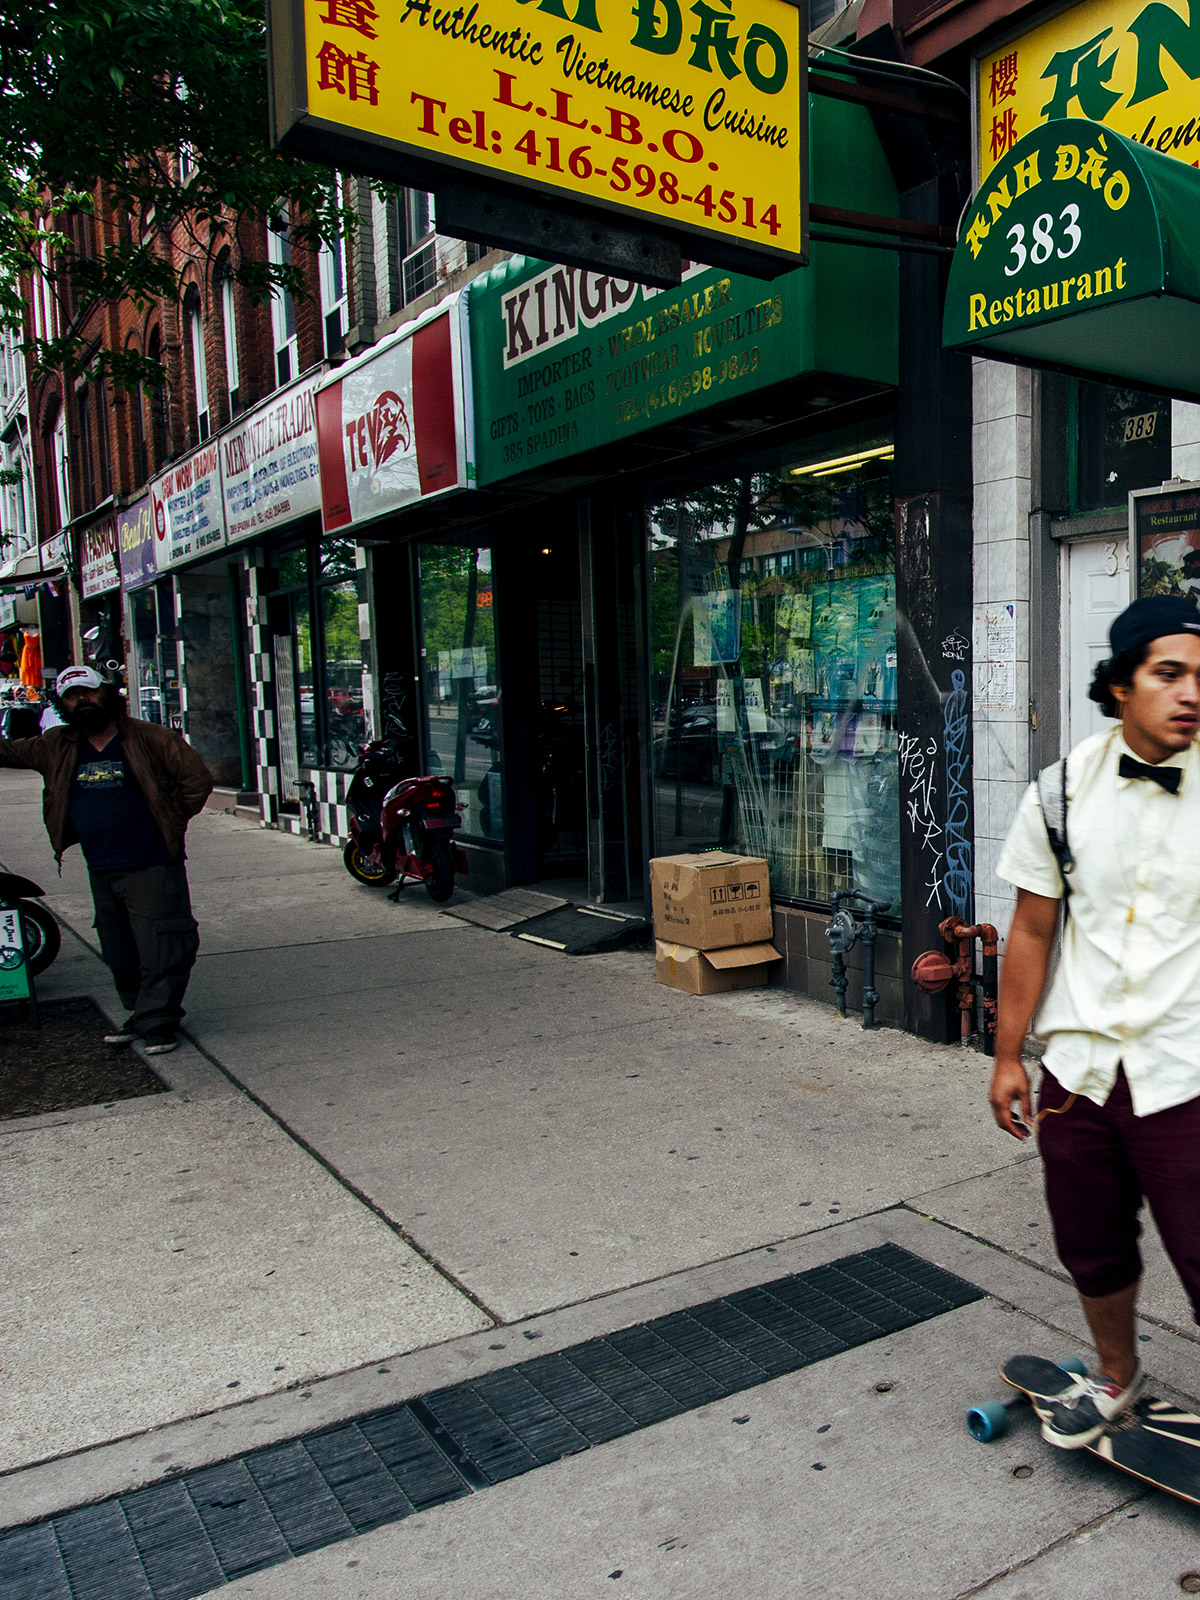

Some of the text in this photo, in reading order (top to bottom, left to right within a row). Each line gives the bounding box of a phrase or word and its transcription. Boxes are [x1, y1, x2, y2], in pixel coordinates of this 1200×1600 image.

[399, 0, 544, 65] Authentic
[555, 34, 694, 117] Vietnamese
[703, 87, 790, 150] Cuisine
[492, 68, 721, 171] L.L.B.O.
[410, 91, 782, 237] Tel: 416-598-4514
[965, 150, 1042, 260] ANH
[1003, 202, 1083, 277] 383
[517, 277, 732, 399] IMPORTER WHOLESALER
[967, 257, 1127, 333] Restaurant
[490, 295, 783, 441] GIFTS TOYS BAGS FOOTWEAR NOVELTIES
[277, 388, 318, 448] TRADIN
[526, 420, 578, 455] SPADINA
[1126, 414, 1155, 440] 383
[1151, 512, 1198, 526] Restaurant
